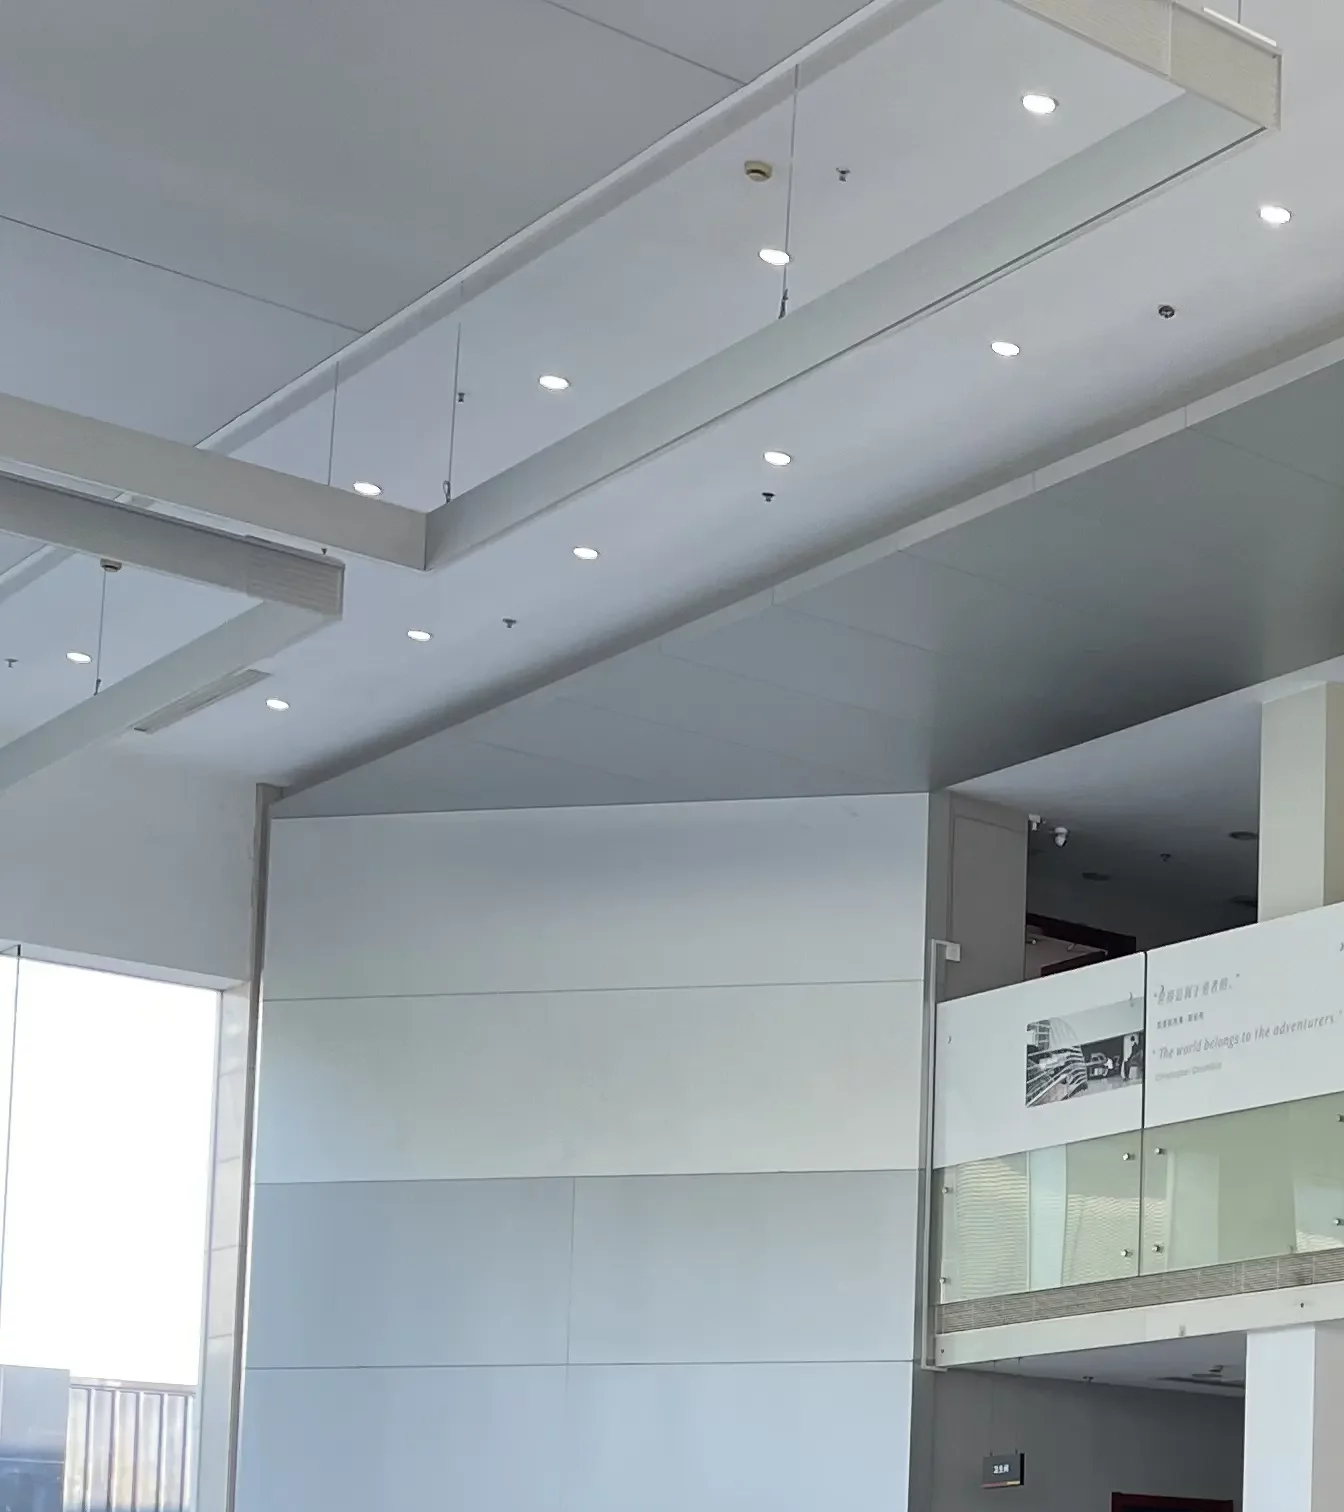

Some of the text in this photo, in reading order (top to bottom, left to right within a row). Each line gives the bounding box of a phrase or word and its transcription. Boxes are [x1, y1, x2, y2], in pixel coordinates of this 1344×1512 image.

[1176, 1039, 1202, 1056] world
[1203, 1033, 1240, 1050] belongs
[1241, 1031, 1252, 1043] to
[1254, 1024, 1270, 1040] the
